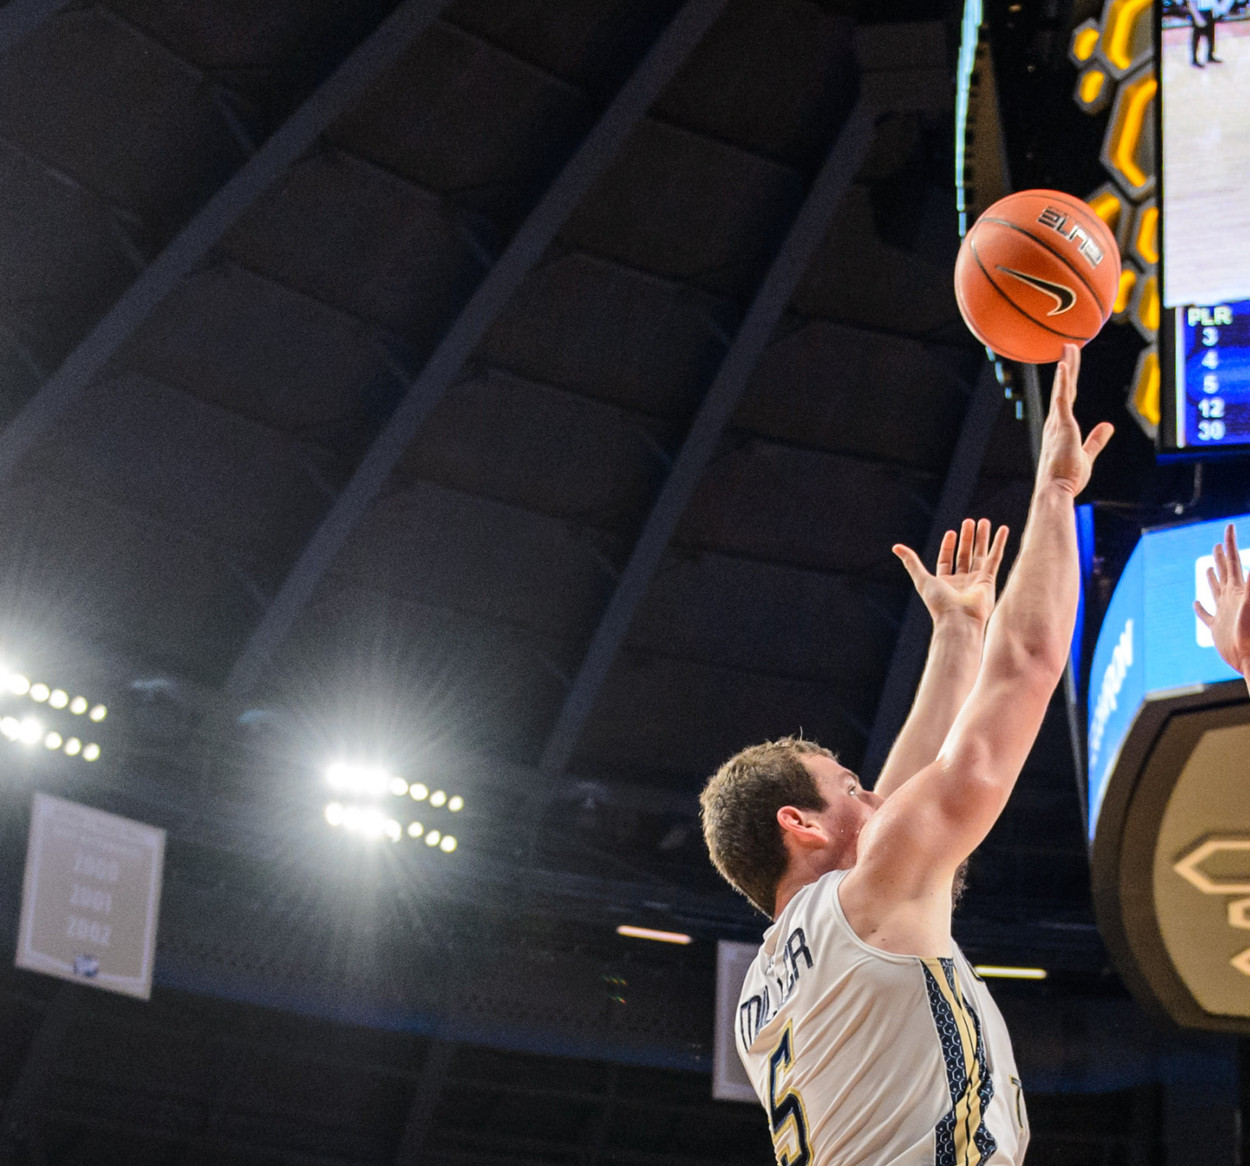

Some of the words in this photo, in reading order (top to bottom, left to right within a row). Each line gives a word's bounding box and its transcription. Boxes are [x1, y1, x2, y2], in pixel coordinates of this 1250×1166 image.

[1187, 306, 1233, 327] PLR
[1201, 326, 1219, 347] 3
[1201, 349, 1219, 370] 4
[1198, 397, 1225, 418] 12
[1197, 419, 1225, 441] 30
